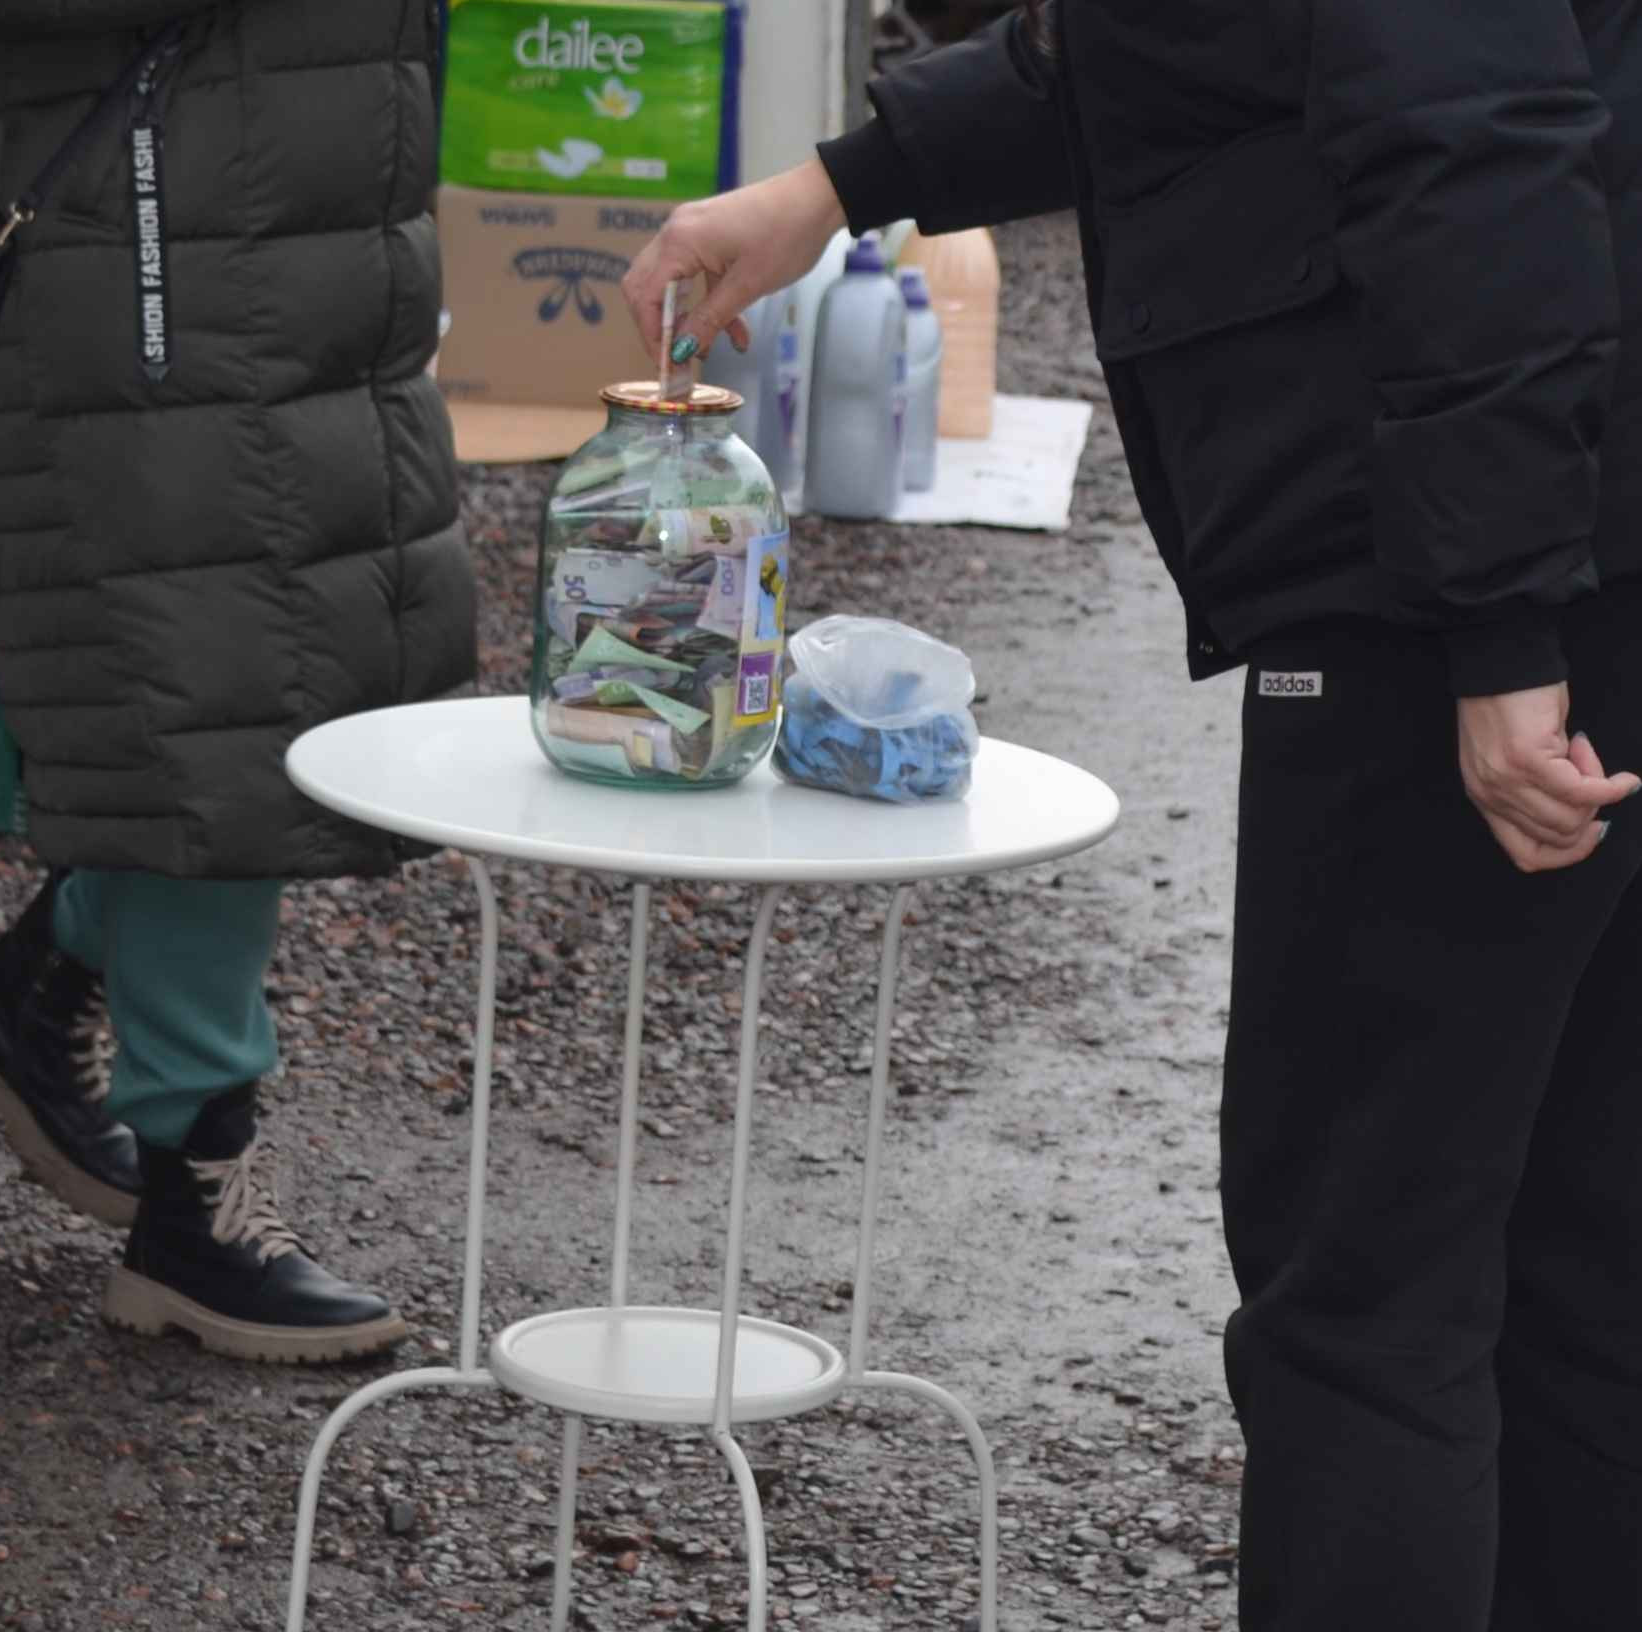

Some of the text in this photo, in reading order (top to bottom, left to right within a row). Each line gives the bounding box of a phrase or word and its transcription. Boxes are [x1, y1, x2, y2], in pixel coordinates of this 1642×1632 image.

[515, 16, 645, 72] dailee
[137, 198, 163, 288] FASHION
[563, 574, 587, 602] 50
[1264, 674, 1315, 693] adidas
